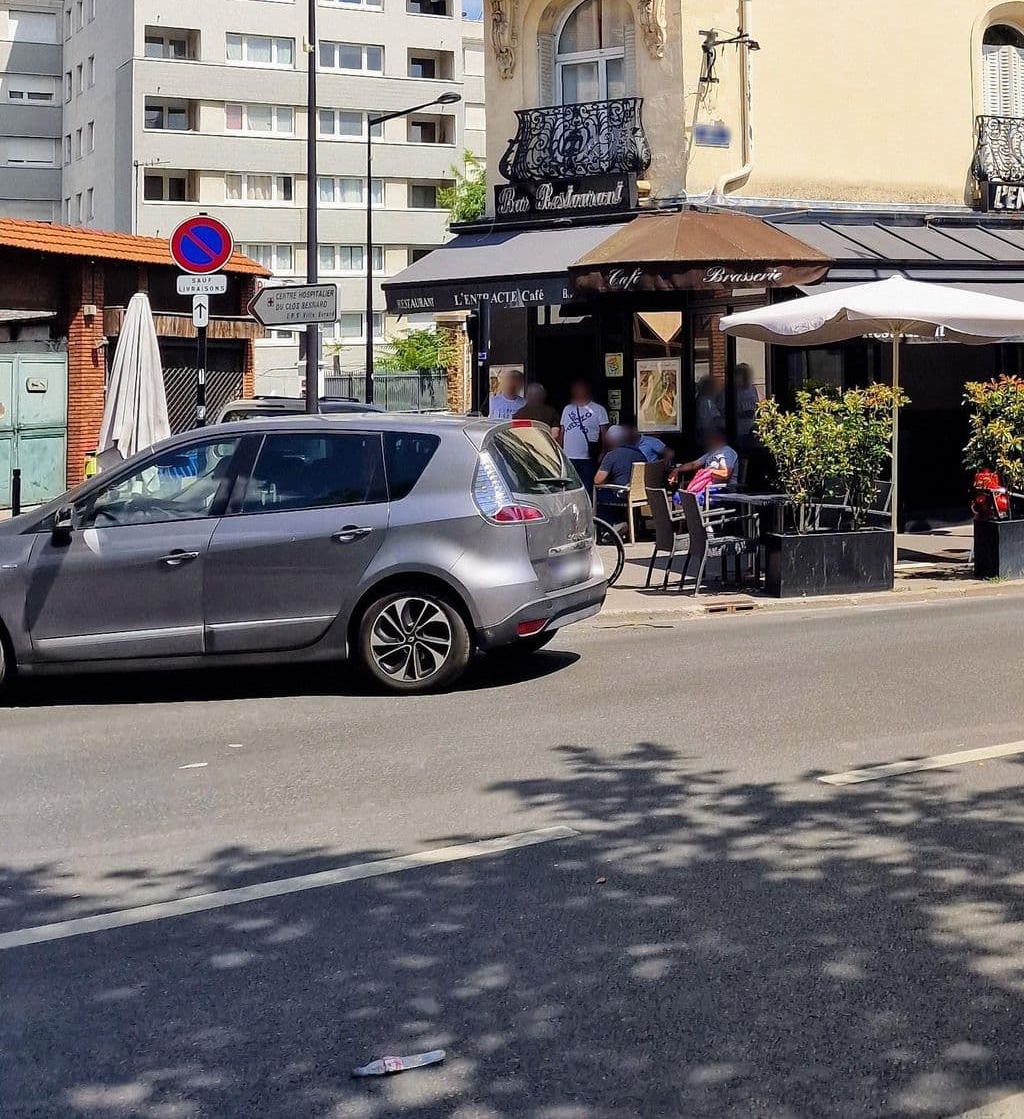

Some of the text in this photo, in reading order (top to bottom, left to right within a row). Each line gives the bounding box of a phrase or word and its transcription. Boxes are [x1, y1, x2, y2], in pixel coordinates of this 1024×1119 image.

[498, 181, 624, 214] Bar Restaurant
[608, 267, 643, 290] Café
[703, 266, 783, 283] Brasserie
[275, 289, 334, 300] CENTRE HOSPITALIER
[521, 288, 545, 302] Café
[275, 303, 284, 311] DU
[285, 302, 300, 311] CLOS
